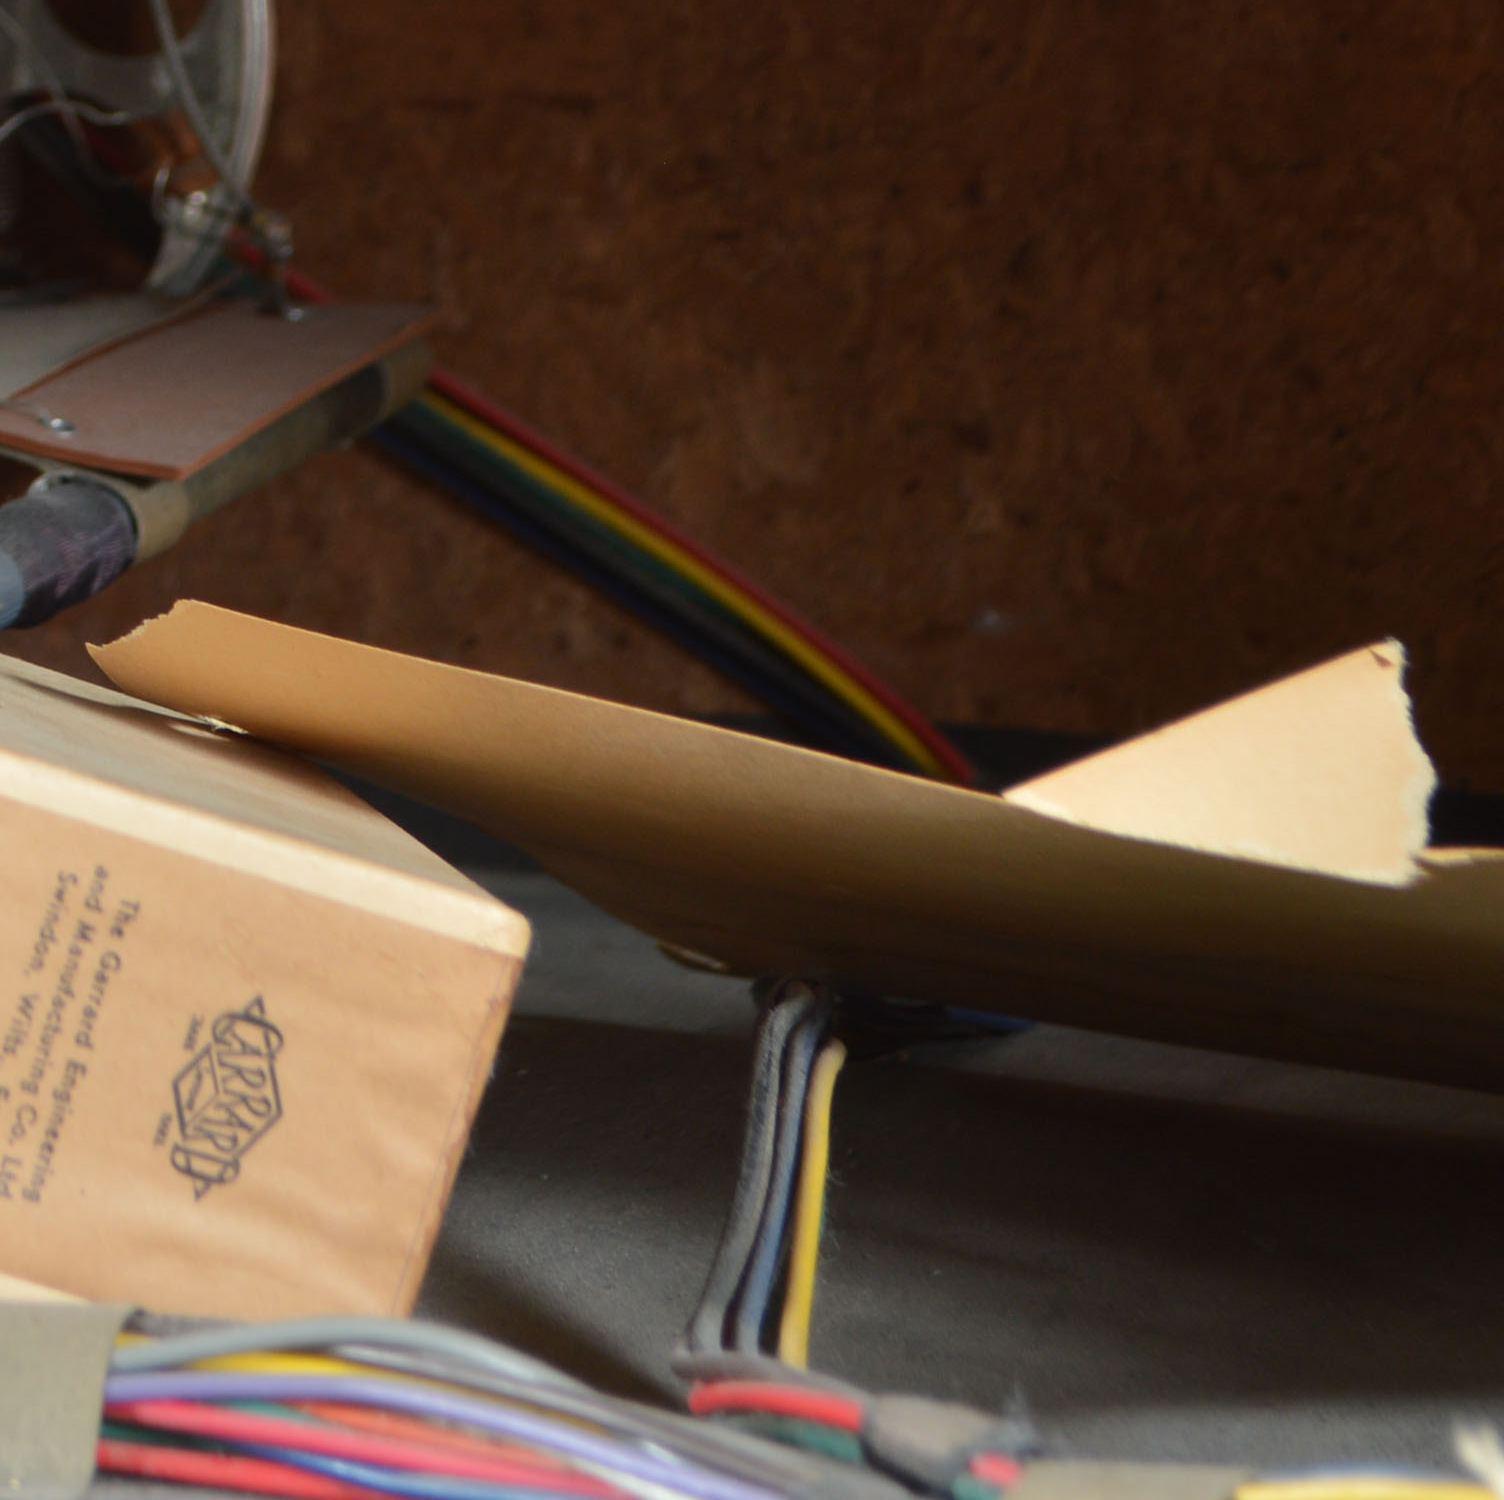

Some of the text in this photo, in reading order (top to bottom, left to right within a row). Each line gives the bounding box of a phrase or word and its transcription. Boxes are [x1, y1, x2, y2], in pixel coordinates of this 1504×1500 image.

[84, 865, 109, 914] and
[20, 918, 97, 1095] Manufacturing
[21, 898, 141, 1204] The Garrard Engineering
[8, 1103, 39, 1146] Co.
